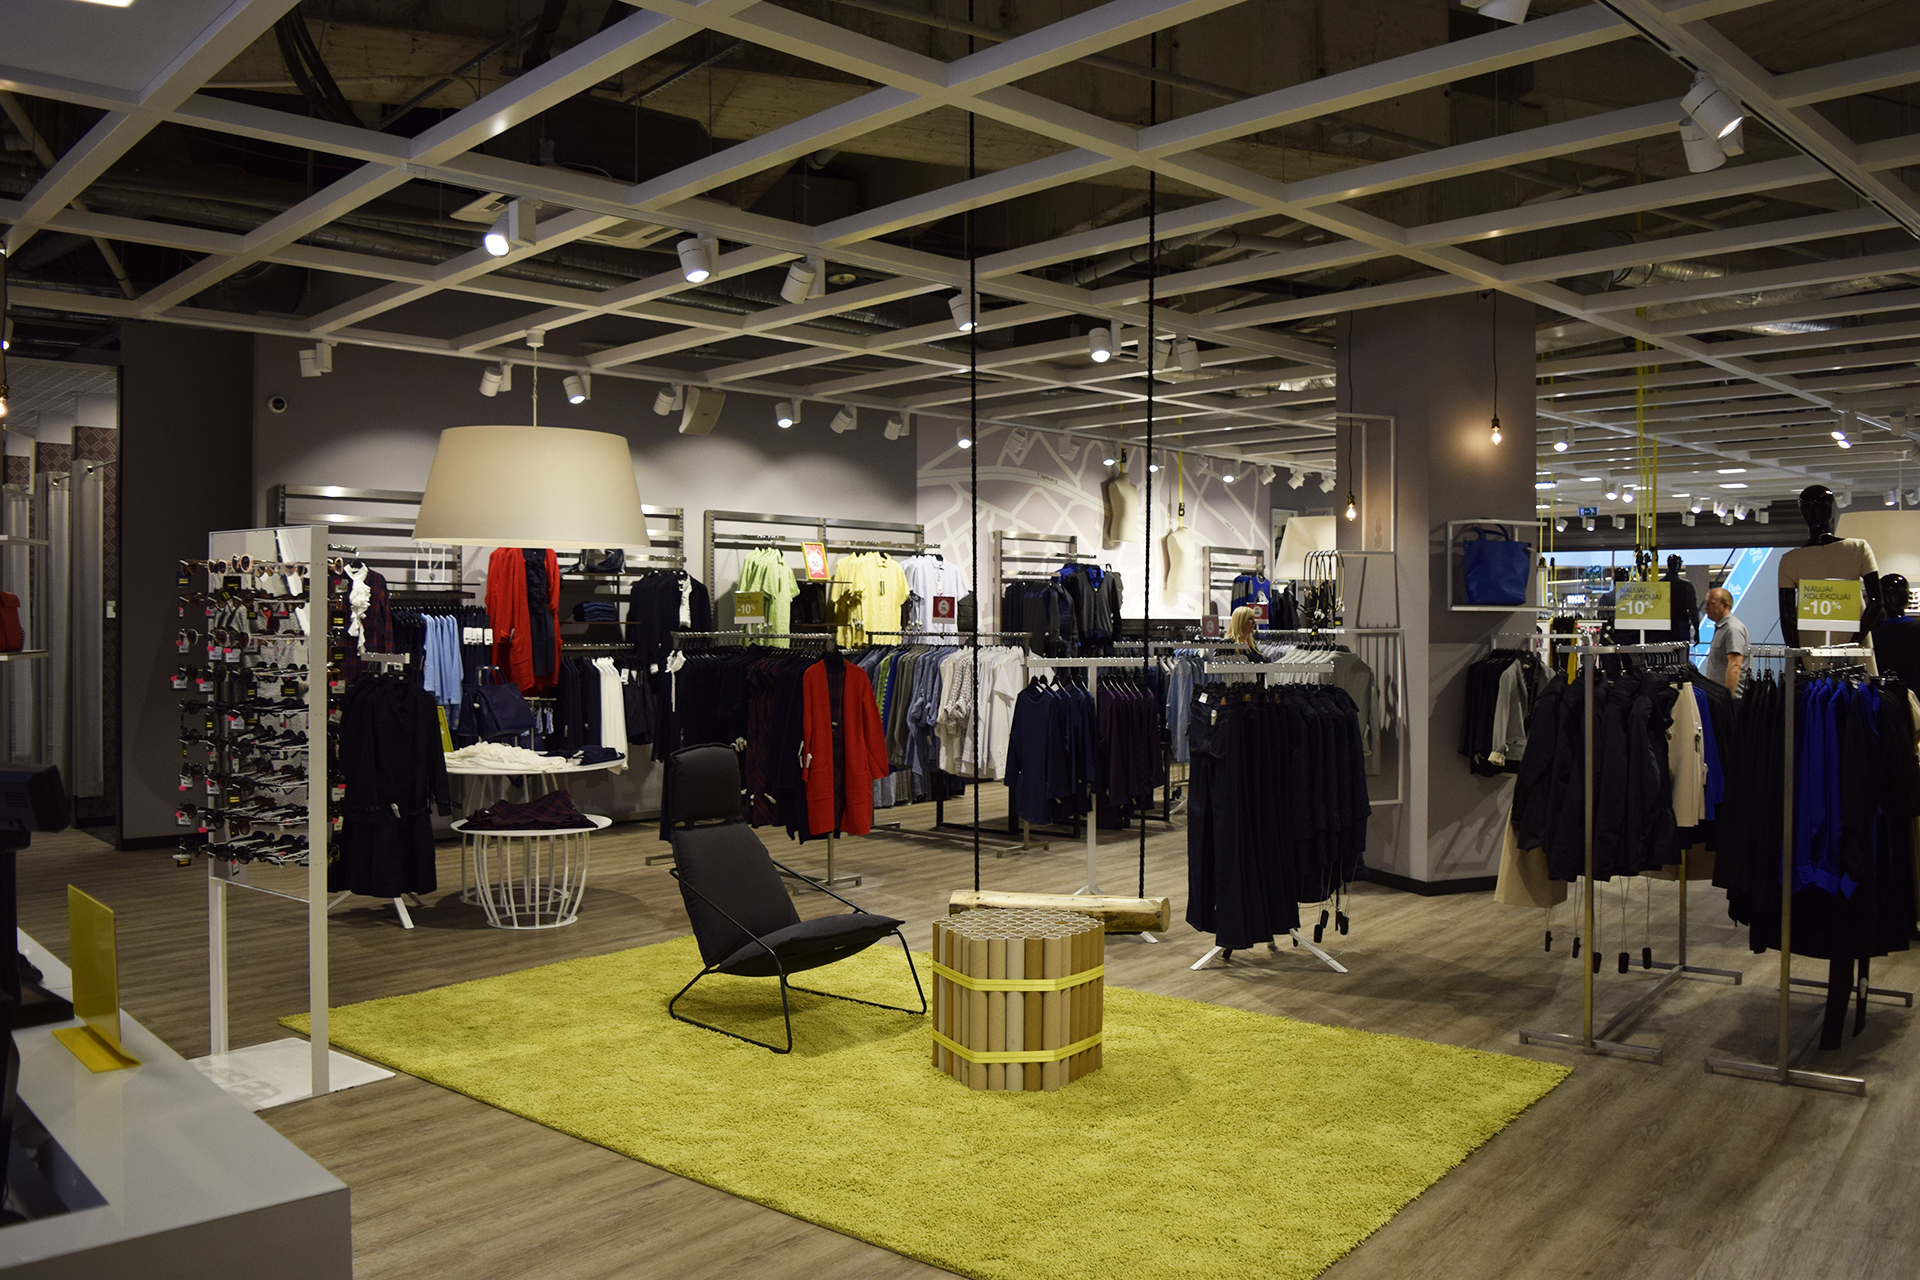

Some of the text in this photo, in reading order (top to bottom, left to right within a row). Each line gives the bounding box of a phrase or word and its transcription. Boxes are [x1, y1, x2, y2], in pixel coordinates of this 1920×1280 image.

[1803, 592, 1851, 600] KOLEKCIJAI
[1619, 601, 1654, 615] -10%
[1803, 600, 1842, 615] -10%
